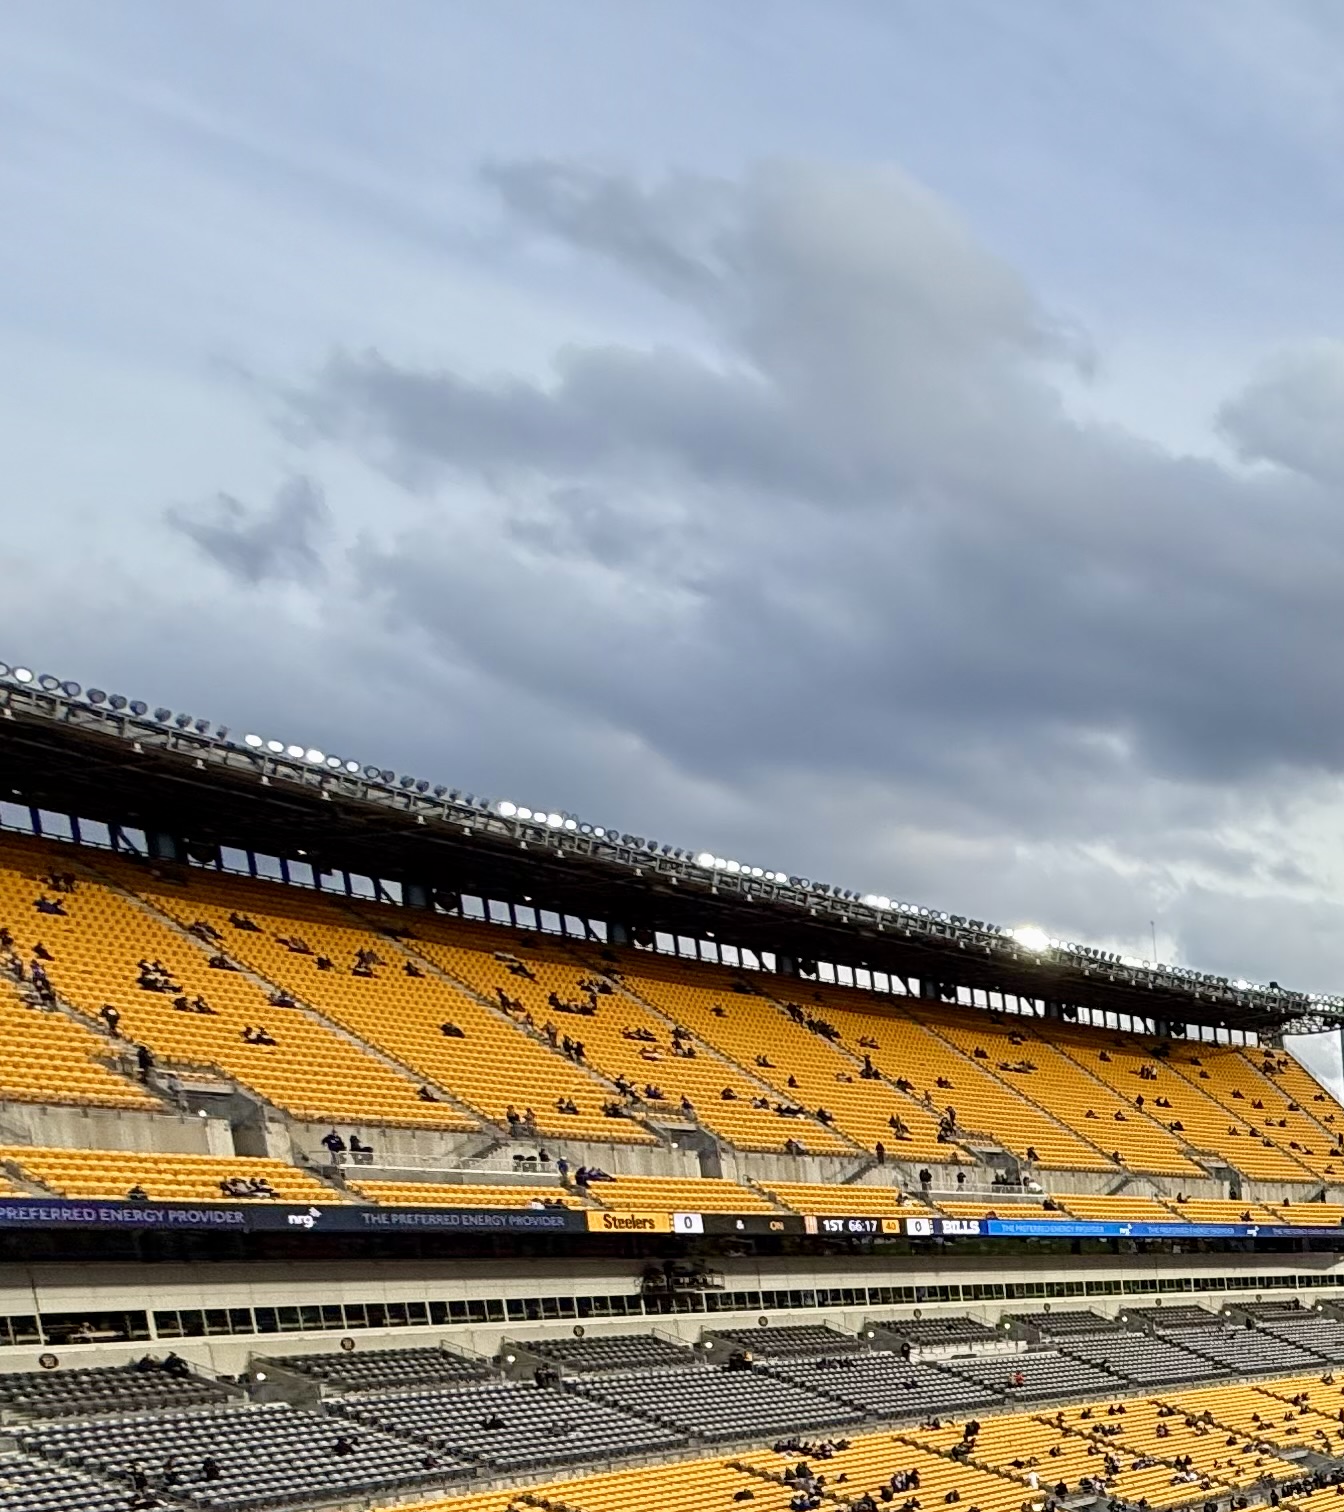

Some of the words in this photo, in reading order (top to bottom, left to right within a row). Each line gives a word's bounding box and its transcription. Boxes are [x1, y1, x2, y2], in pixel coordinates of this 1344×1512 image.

[100, 1209, 165, 1223] ENERGY
[168, 1210, 246, 1224] PROVIDER
[363, 1213, 390, 1225] THE
[391, 1213, 460, 1226] PREFERRED
[462, 1214, 507, 1227] ENERGY
[603, 1214, 655, 1230] Steelers
[684, 1216, 692, 1229] 0
[823, 1219, 844, 1232] 1ST
[915, 1221, 922, 1232] 0
[942, 1220, 980, 1234] BILLS
